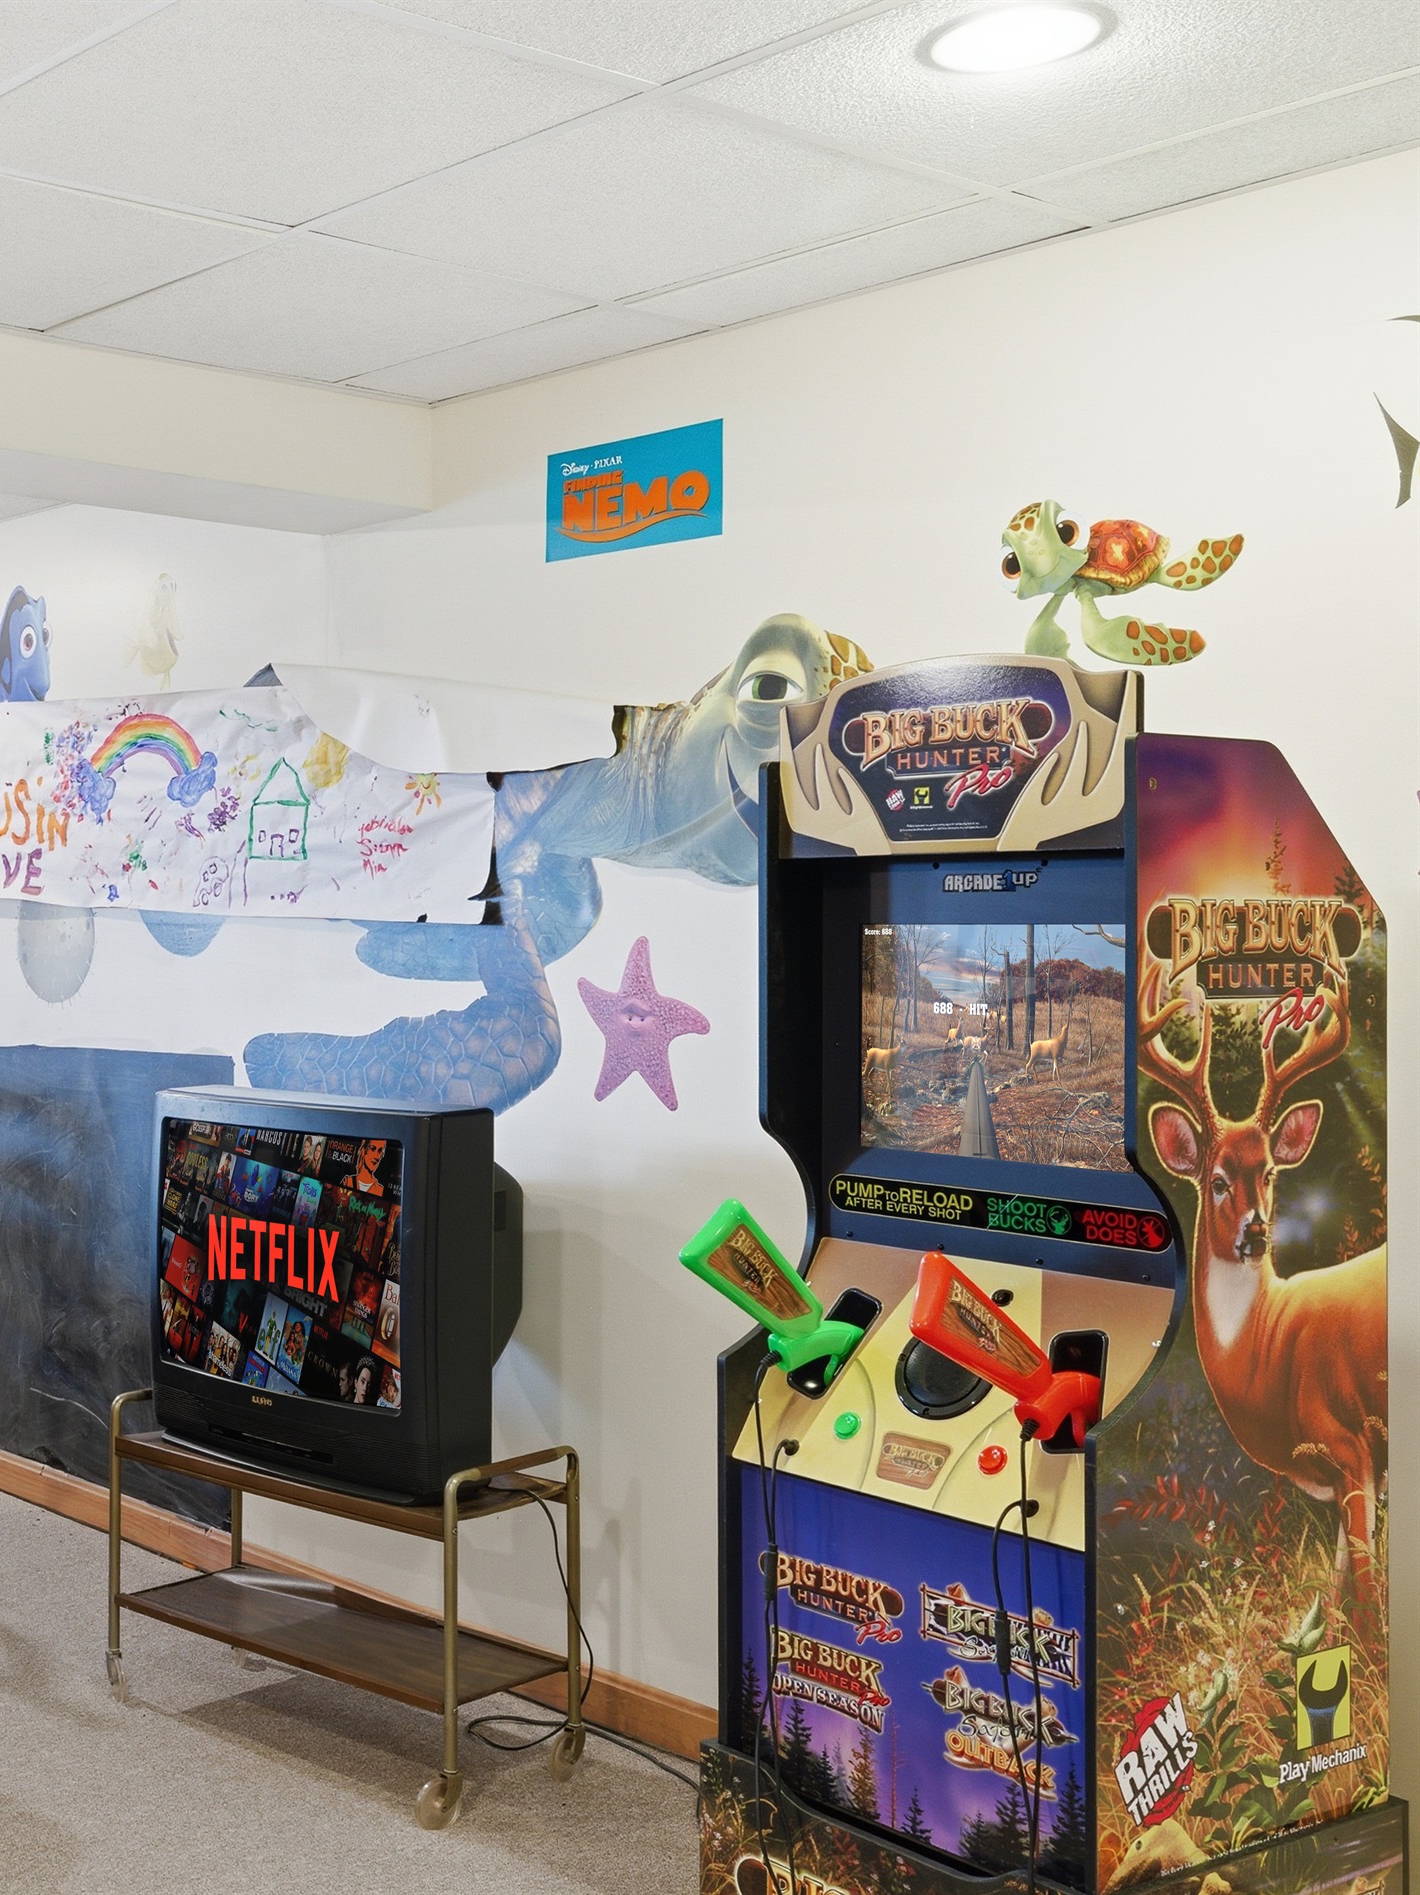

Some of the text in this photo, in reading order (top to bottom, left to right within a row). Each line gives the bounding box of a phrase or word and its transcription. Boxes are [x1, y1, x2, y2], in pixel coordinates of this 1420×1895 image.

[560, 455, 623, 476] Disney PIXAR
[564, 470, 624, 494] FINDING
[561, 469, 710, 532] NEMO
[861, 699, 1036, 768] BIG BUCK
[896, 746, 1001, 770] HUNTER
[944, 763, 1013, 809] Pro
[864, 928, 880, 936] Score:
[1167, 898, 1346, 985] BIG BUCK
[1208, 962, 1315, 989] HUNTER
[933, 1001, 954, 1015] 688
[1259, 987, 1325, 1050] Pro
[256, 1129, 283, 1147] NARCOS
[330, 1140, 355, 1154] ORANGE
[332, 1150, 353, 1164] BLACK
[835, 1180, 884, 1199] PUMP
[899, 1187, 973, 1212] RELOAD
[844, 1196, 962, 1221] AFTER EVERY SHOT
[986, 1198, 1048, 1218] SHOOT
[987, 1214, 1047, 1234] BUCKS
[1082, 1209, 1138, 1230] AVOID
[1086, 1227, 1138, 1246] DOES
[207, 1212, 341, 1304] NETFLIX
[283, 1287, 328, 1318] BRIGHT
[313, 1324, 329, 1340] NETFLIX
[307, 1350, 339, 1378] CROWN
[777, 1554, 892, 1627] BIG BUCK
[797, 1588, 869, 1624] HUNTER
[855, 1619, 903, 1646] Pro
[947, 1604, 1051, 1664] BIG CK
[771, 1625, 884, 1697] BIG BUCK
[795, 1661, 861, 1694] HUNTER
[773, 1673, 886, 1733] OPEN SEASON
[857, 1686, 891, 1707] Pro
[945, 1680, 985, 1714] BIG
[946, 1731, 1056, 1790] OUTBACK
[1115, 1691, 1191, 1805] RAW
[1127, 1730, 1199, 1827] THRILLS
[1280, 1743, 1368, 1785] Play Mechanix
